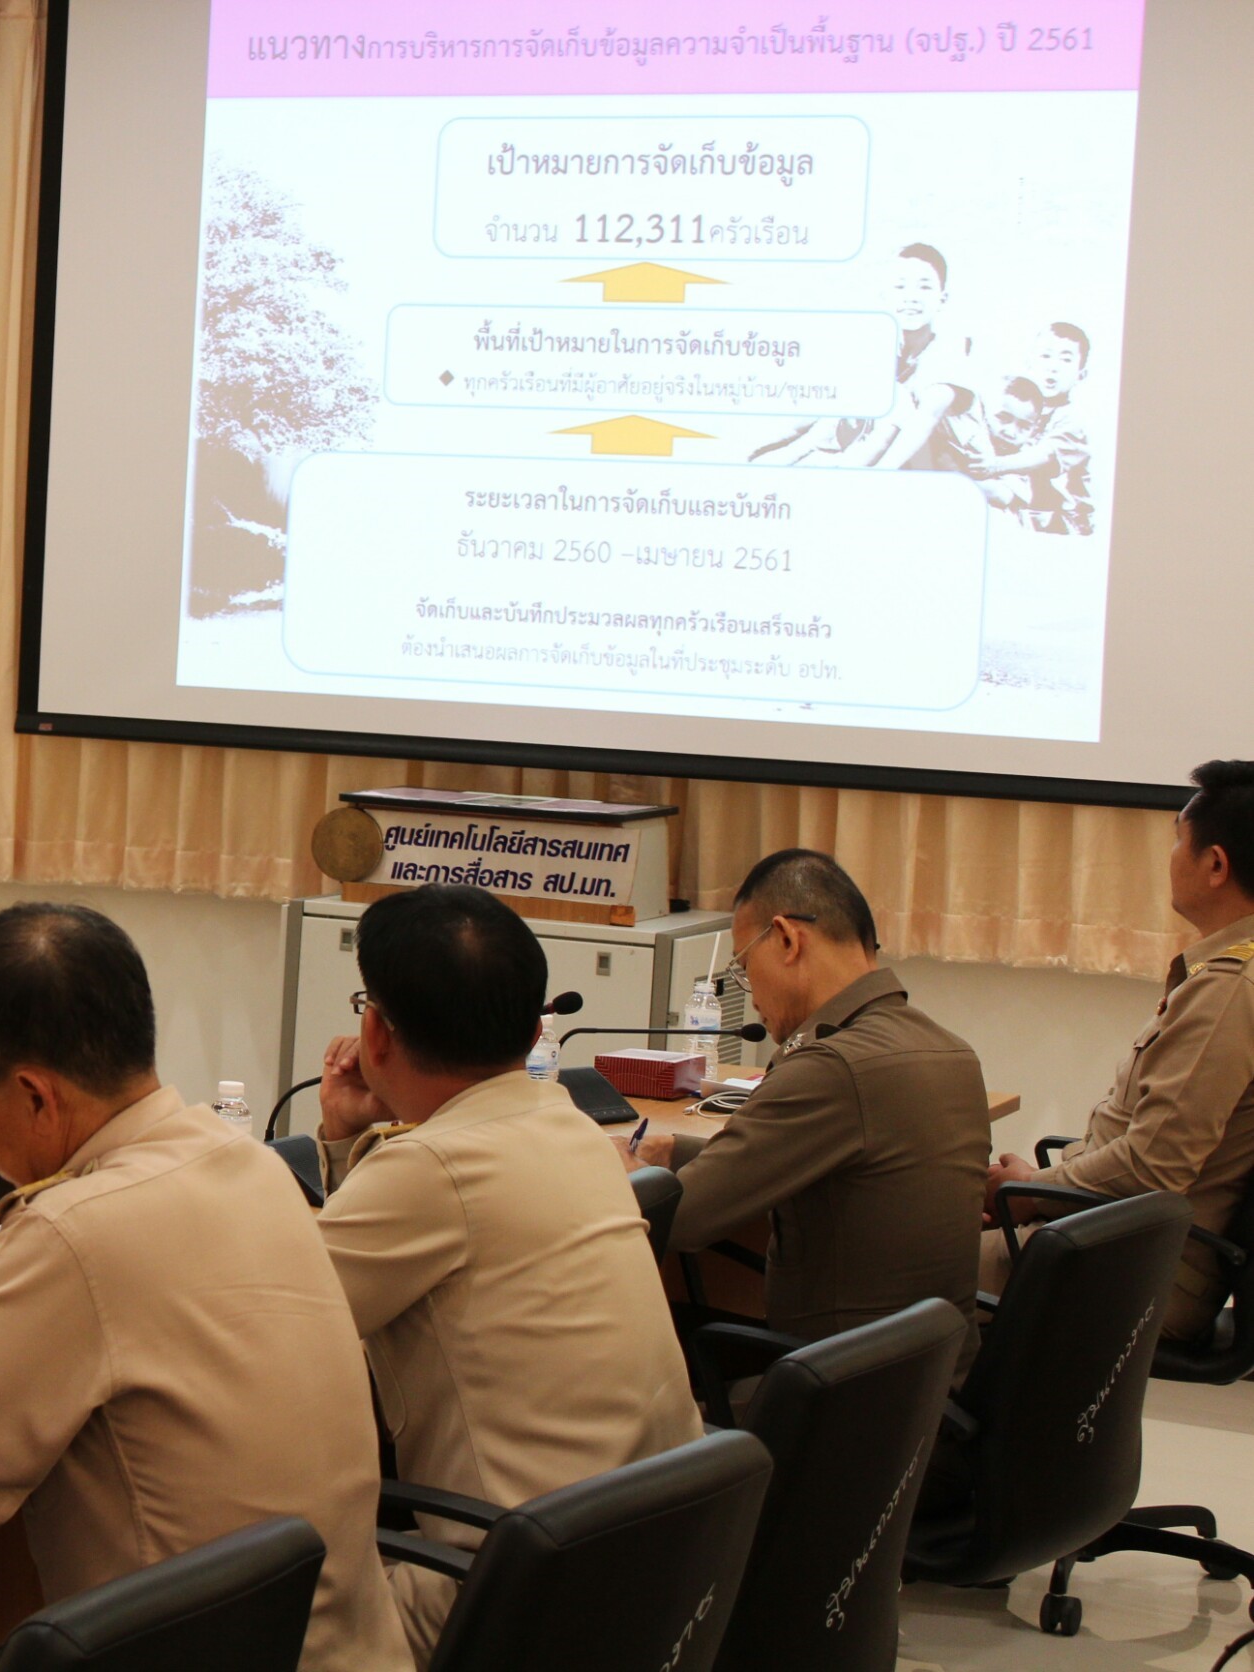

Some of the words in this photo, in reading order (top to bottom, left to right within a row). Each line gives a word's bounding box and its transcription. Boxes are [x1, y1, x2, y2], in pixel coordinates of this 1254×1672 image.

[248, 15, 894, 66] แนวทางการบริหารการจัดเก็บข้อมูลความจำเป็นพื้นฐาน
[906, 25, 988, 63] (จปฐ.)
[997, 20, 1018, 53] ปี
[1027, 27, 1094, 52] 2561
[487, 140, 814, 187] เป้าหมายการจัดเก็บข้อมูล
[484, 214, 558, 243] จำนวน
[473, 319, 802, 367] พื้นที่เป้าหมายในการจัดเก็บข้อมูล
[464, 485, 792, 520] ระยะเวลาในการจัดเก็บและบันทึก
[456, 529, 544, 560] ธันวาคม
[552, 538, 612, 564] 2560
[732, 546, 793, 572] 2561
[415, 596, 833, 640] จัดเก็บและบันทึกประมวลผลทุกครัวเรือนเสร็จแล้ว
[798, 658, 843, 681] อปท.
[384, 823, 631, 863] ศูนย์เทคโนโลยีสารสนเทศ
[390, 857, 534, 891] และการสื่อสาร
[542, 872, 617, 898] สป.มท.
